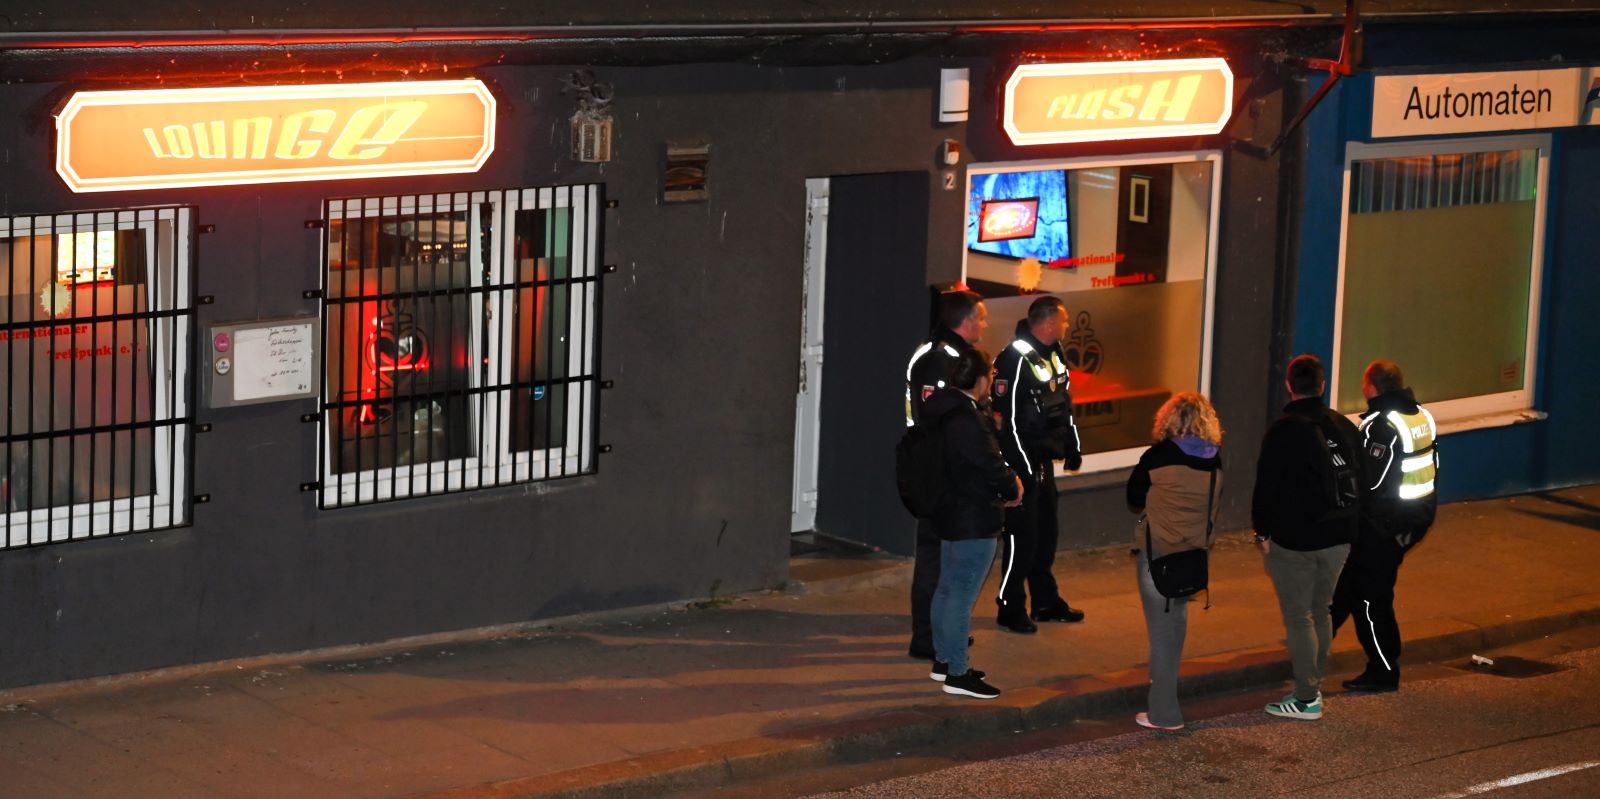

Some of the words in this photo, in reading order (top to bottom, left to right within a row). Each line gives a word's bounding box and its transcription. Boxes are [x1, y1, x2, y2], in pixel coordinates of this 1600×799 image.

[1046, 74, 1202, 121] FLASH
[1403, 84, 1552, 121] Automaten
[945, 174, 955, 189] 2
[0, 324, 88, 341] trntionaer
[46, 346, 116, 361] reffpunk
